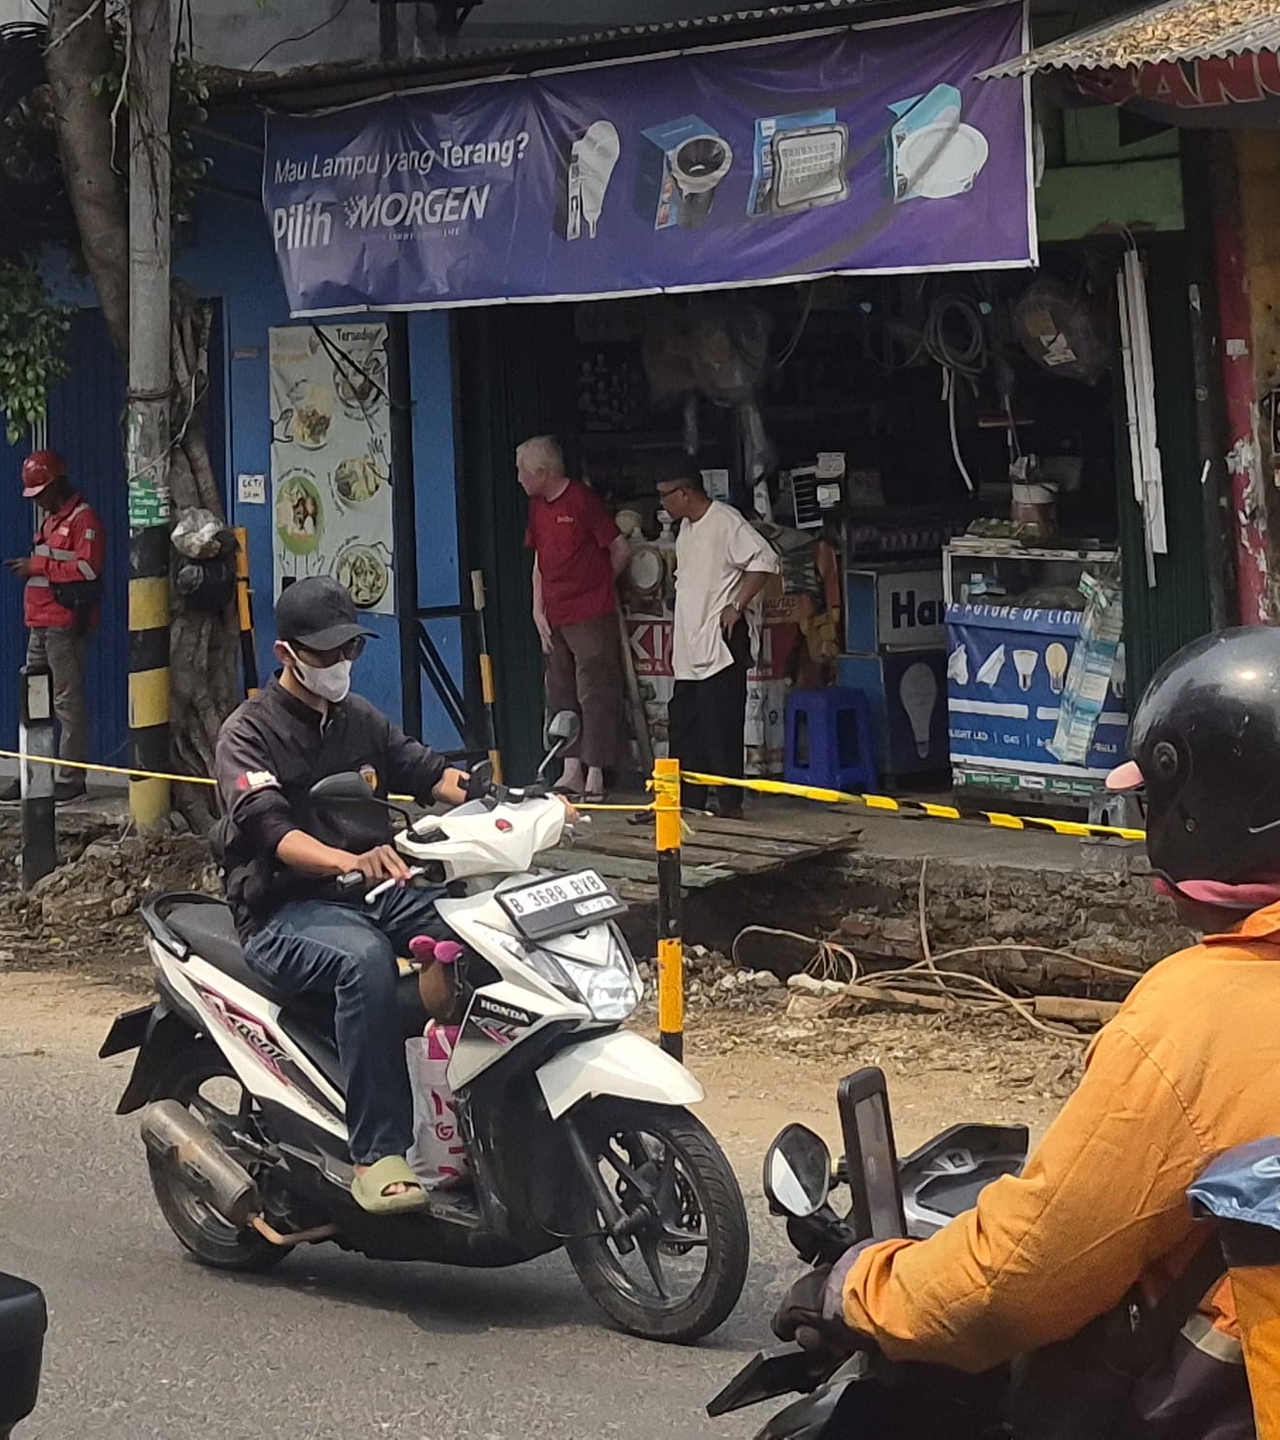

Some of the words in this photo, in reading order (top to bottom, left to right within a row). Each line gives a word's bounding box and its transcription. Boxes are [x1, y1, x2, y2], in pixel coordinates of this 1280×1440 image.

[274, 158, 308, 184] Mau
[311, 153, 379, 182] Lampu
[384, 147, 436, 178] yang
[440, 131, 530, 168] Terang?
[273, 201, 332, 254] Pilih
[344, 183, 491, 229] MORGEN
[1022, 607, 1040, 622] OF
[1047, 610, 1082, 625] LIGH
[509, 898, 524, 914] B
[481, 998, 530, 1023] HONDA
